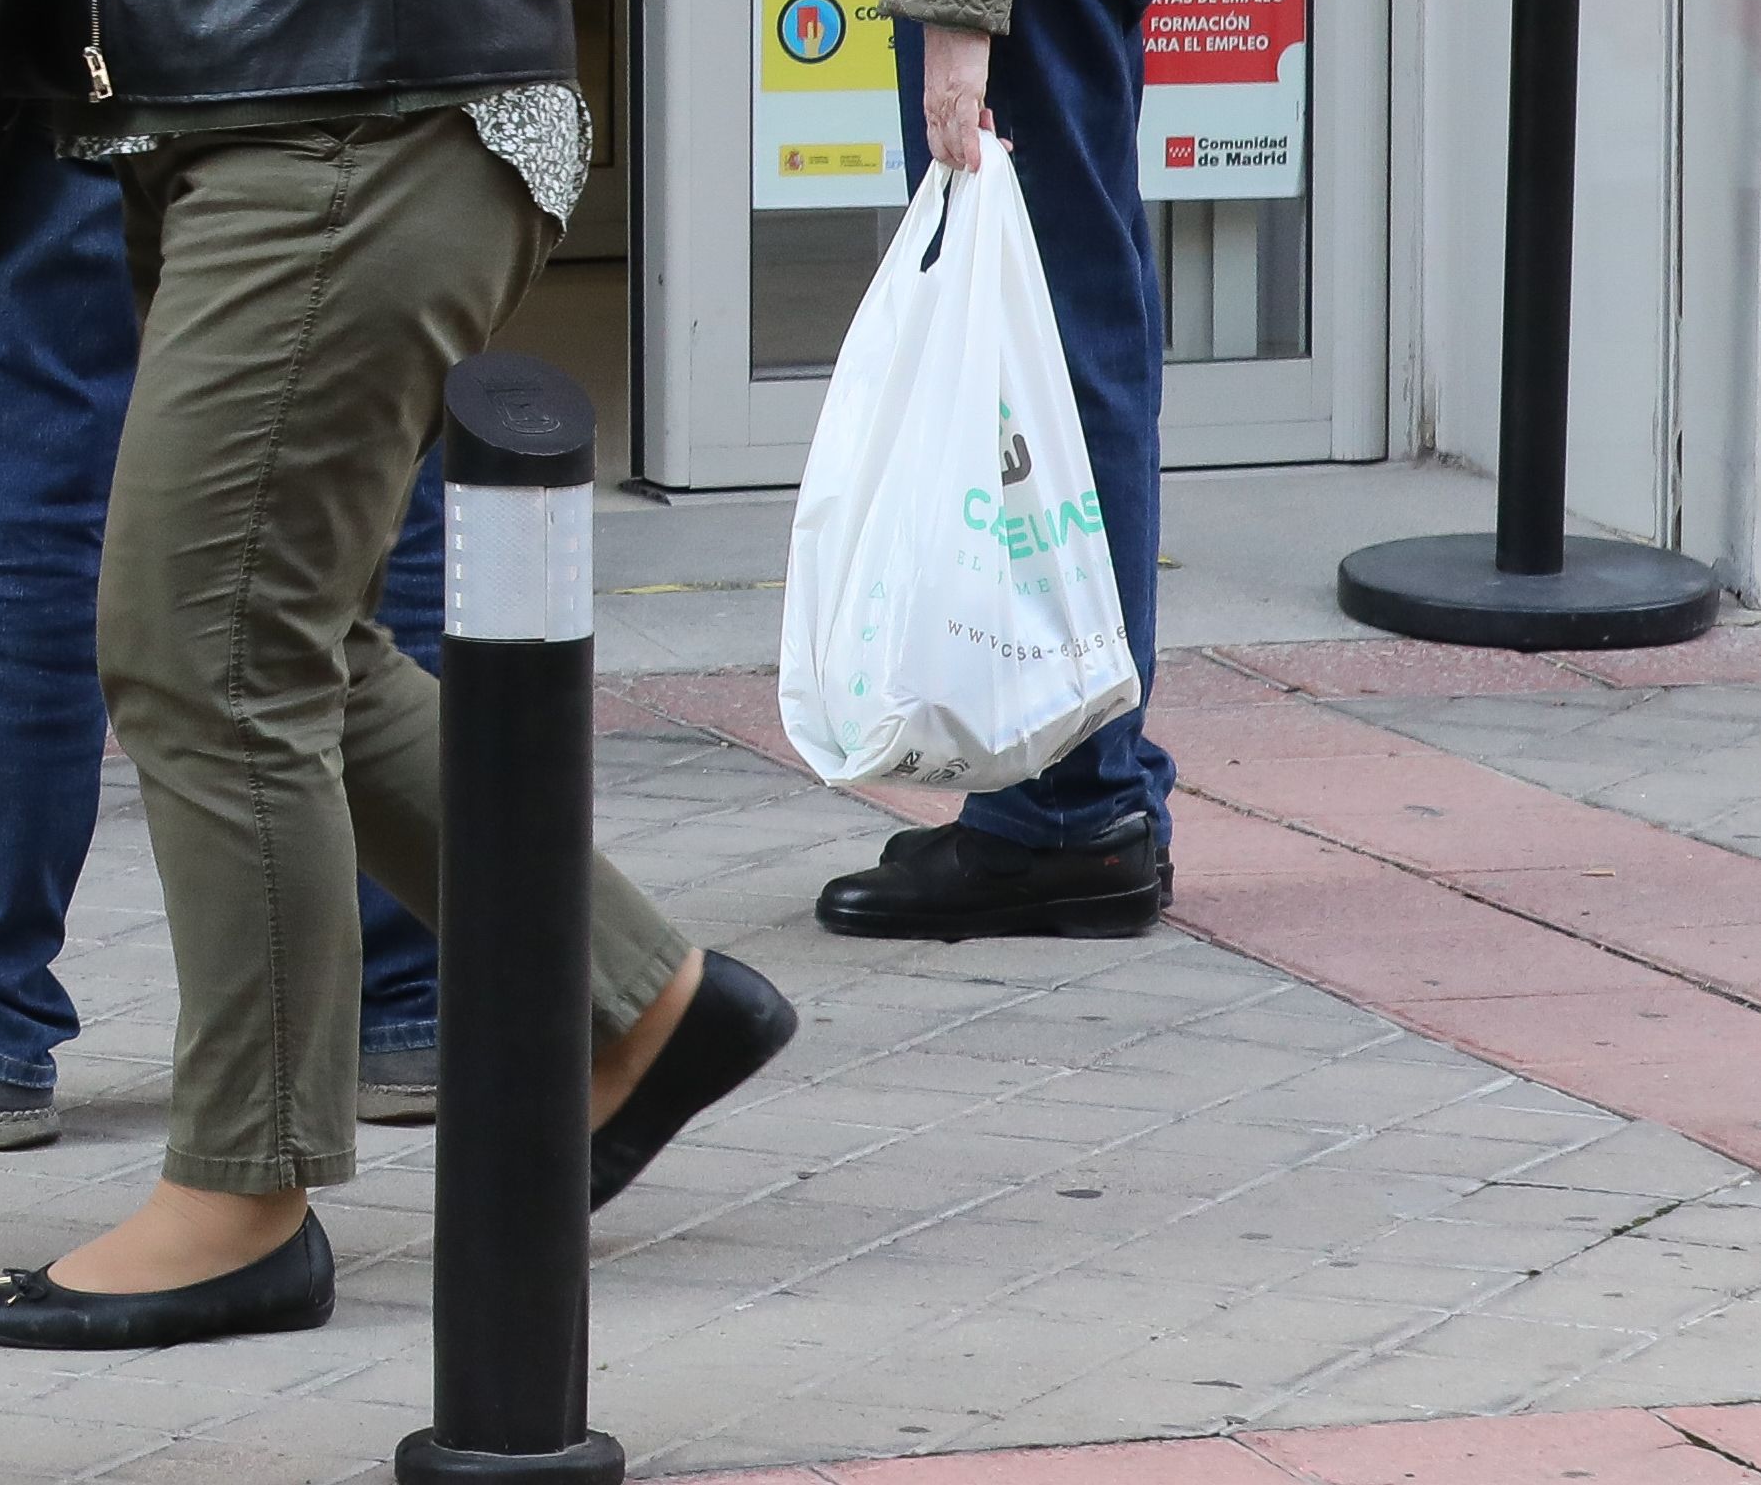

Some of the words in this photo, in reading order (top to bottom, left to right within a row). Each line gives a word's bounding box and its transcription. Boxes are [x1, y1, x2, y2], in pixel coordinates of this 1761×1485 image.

[1151, 11, 1250, 31] FORMACIÓN
[1184, 37, 1201, 51] EL
[1206, 35, 1269, 51] EMPLEO
[1198, 136, 1287, 150] Comunidad
[1198, 152, 1219, 167] de
[1226, 150, 1287, 166] Madrid
